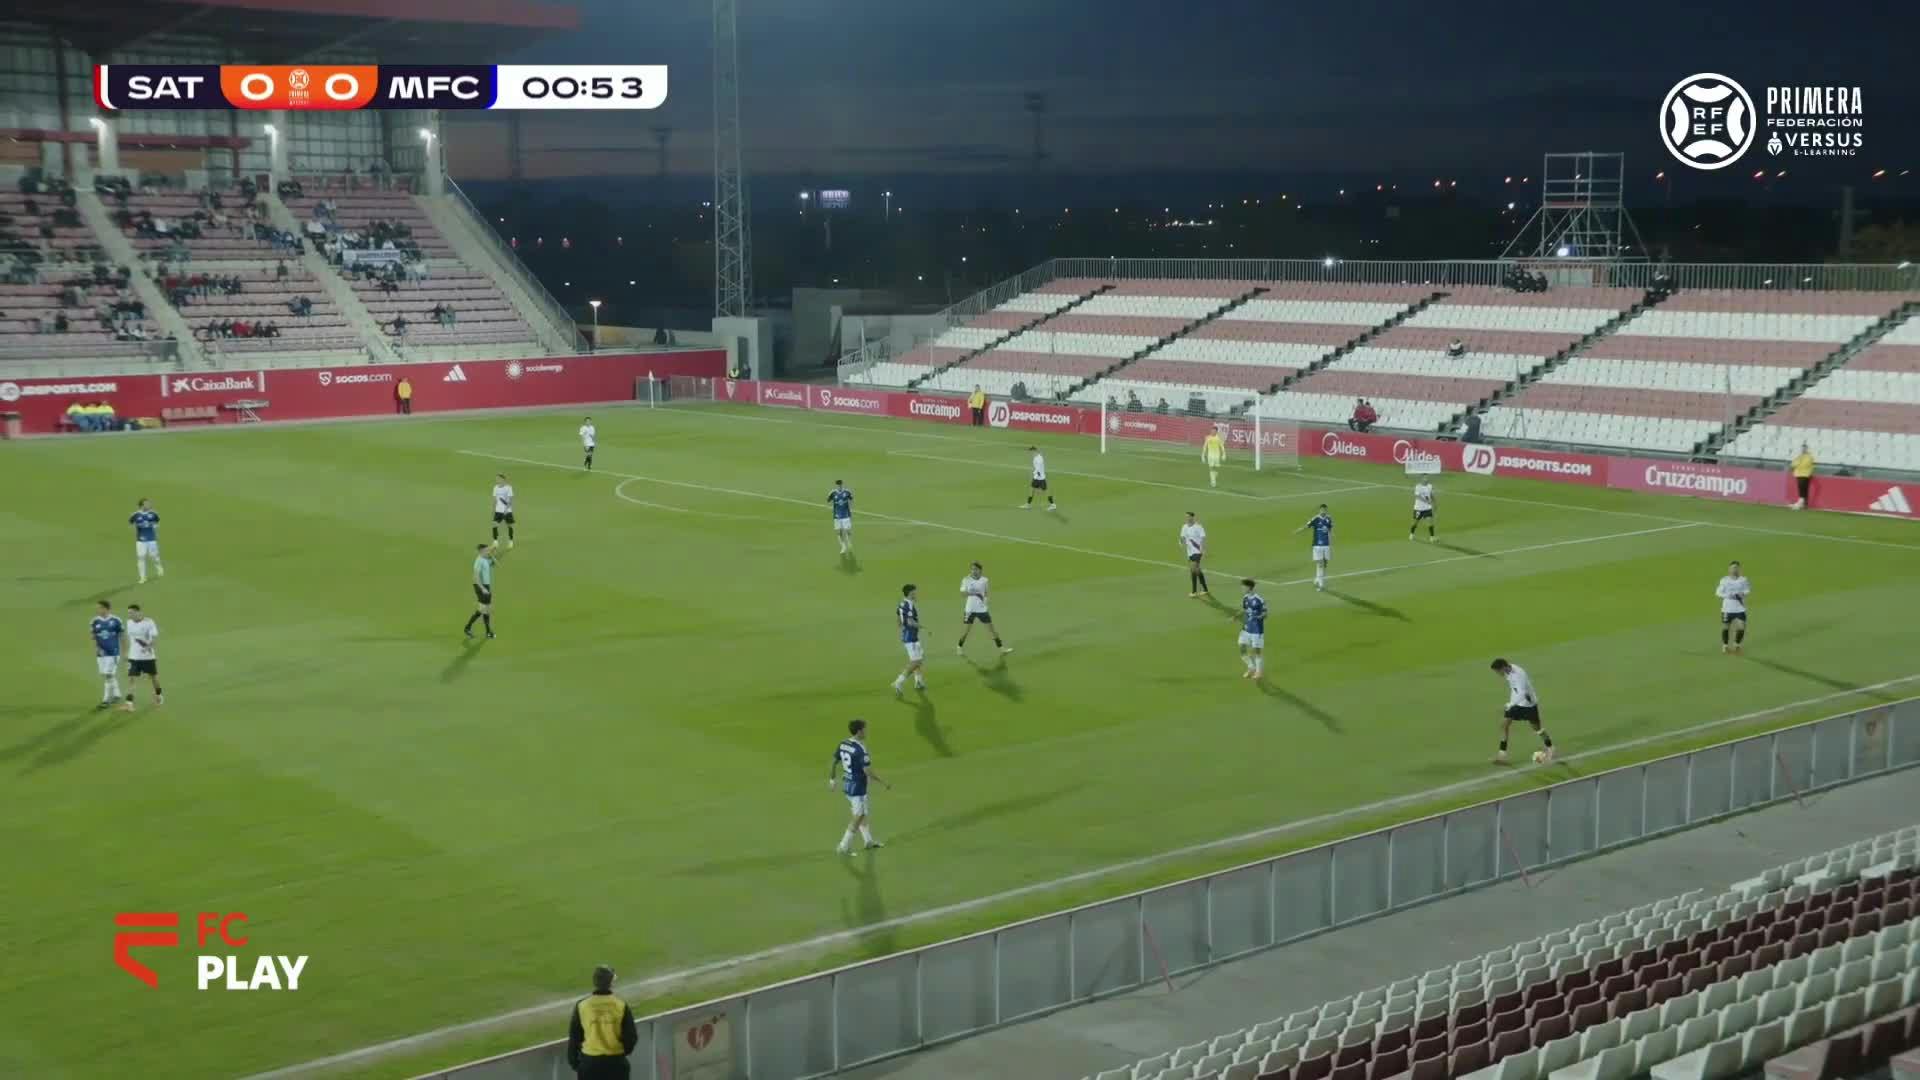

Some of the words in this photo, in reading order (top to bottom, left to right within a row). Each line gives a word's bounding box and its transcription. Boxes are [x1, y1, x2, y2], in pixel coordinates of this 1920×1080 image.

[191, 376, 255, 392] CaixaBank
[335, 373, 392, 384] socios.com
[833, 396, 881, 409] socios.com
[909, 399, 961, 419] Cruzcampo
[1010, 409, 1071, 425] JDSPORTS.COM
[1232, 429, 1270, 446] SEVIA
[1272, 432, 1287, 448] FC
[1330, 439, 1366, 457] Midea
[1402, 447, 1440, 462] Midea
[1497, 455, 1592, 476] JDSPORTS.COM
[1645, 464, 1747, 497] Cruzcampo
